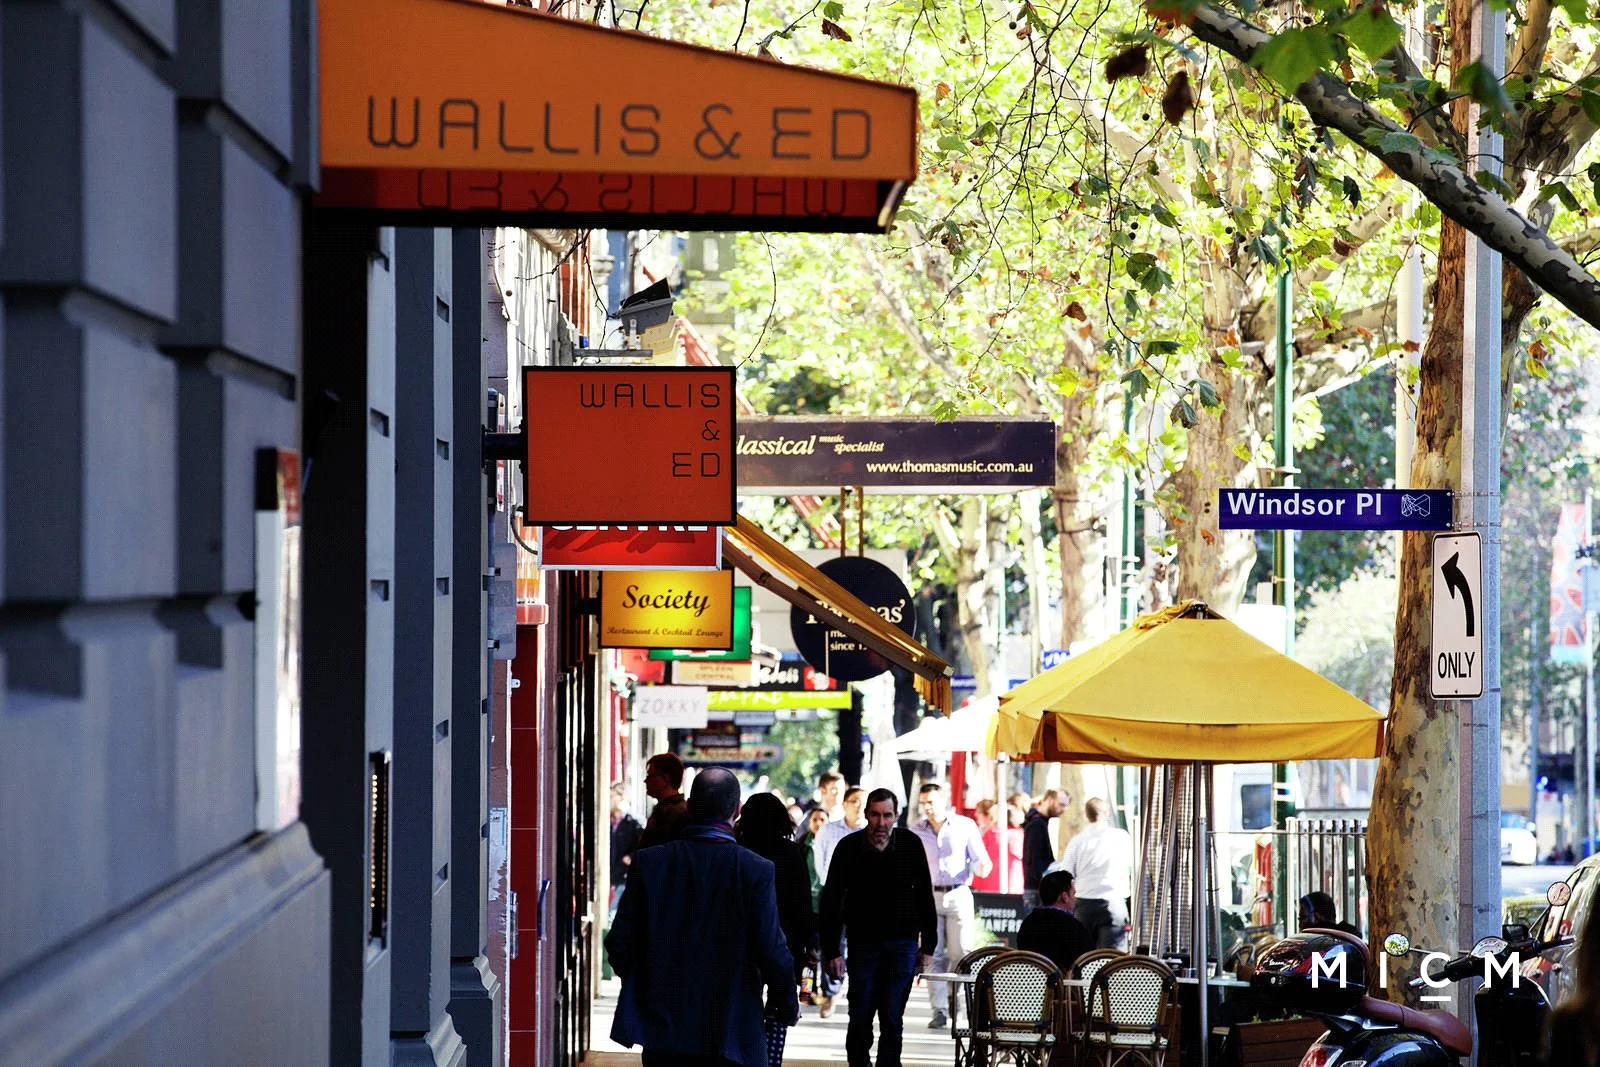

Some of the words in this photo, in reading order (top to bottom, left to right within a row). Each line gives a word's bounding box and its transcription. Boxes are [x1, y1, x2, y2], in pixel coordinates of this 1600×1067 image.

[367, 95, 661, 156] WALLIS
[693, 102, 742, 160] &
[770, 107, 872, 161] ED
[579, 383, 721, 408] WALLIS
[701, 419, 720, 441] &
[737, 434, 816, 455] lassical
[819, 433, 844, 443] music
[834, 441, 884, 453] specialist
[672, 452, 721, 477] ED
[866, 460, 1034, 474] www.thomasmusic.com.au
[1227, 492, 1346, 516] Windsor
[1356, 492, 1382, 516] Pl
[622, 584, 710, 618] Society
[829, 641, 855, 651] since
[1437, 651, 1476, 679] ONLY
